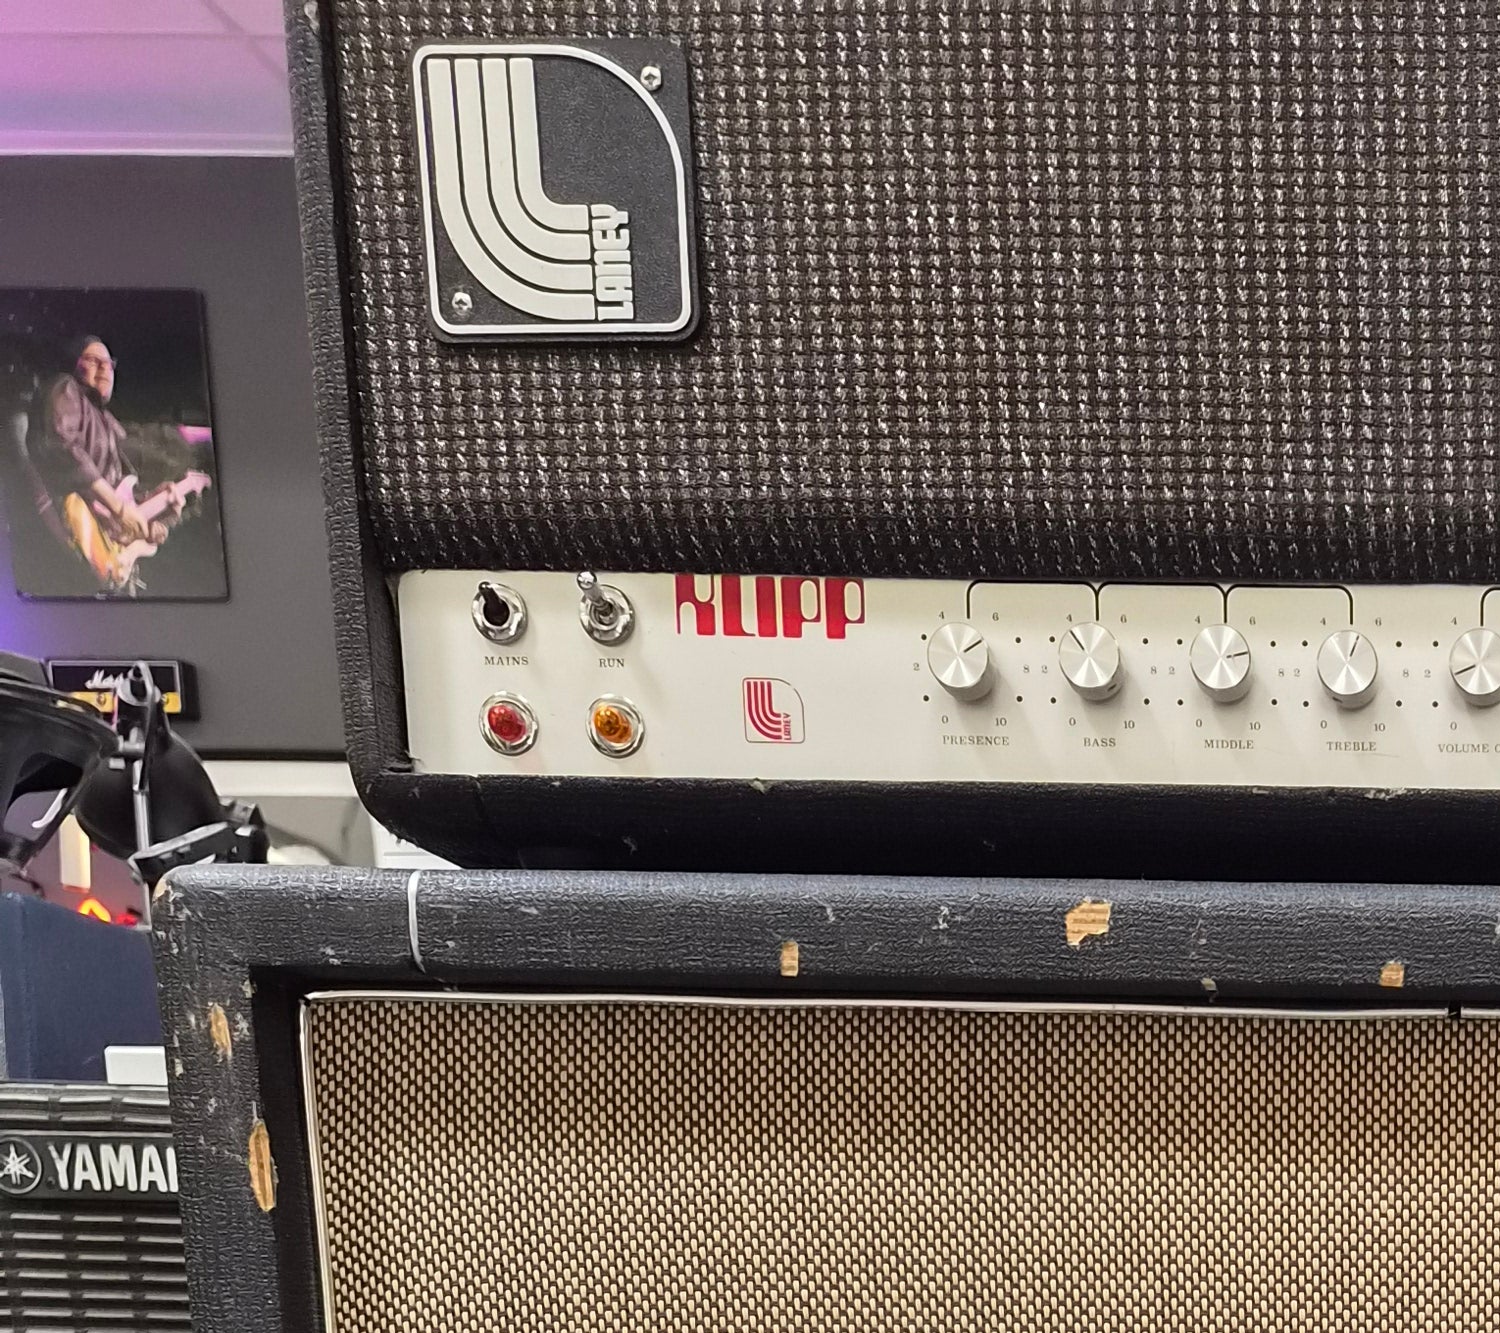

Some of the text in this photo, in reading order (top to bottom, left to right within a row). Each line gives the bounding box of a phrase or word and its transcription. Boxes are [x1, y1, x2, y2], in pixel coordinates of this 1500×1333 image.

[590, 204, 635, 321] LANEY
[675, 573, 865, 639] KLIPP
[938, 611, 945, 620] 4
[992, 612, 999, 621] 6
[1066, 614, 1073, 623] 4
[1120, 614, 1127, 624] 6
[1194, 615, 1201, 624] 4
[1249, 616, 1256, 625] 6
[1320, 617, 1326, 626] 4
[1375, 617, 1382, 627] 6
[1450, 617, 1457, 625] 4
[484, 656, 529, 667] MAINS
[598, 658, 626, 668] RUN
[942, 715, 949, 724] 0
[995, 717, 1007, 726] 10
[1069, 717, 1076, 726] 0
[1195, 719, 1203, 728] 0
[1123, 720, 1135, 729] 10
[1249, 722, 1261, 731] 10
[1320, 720, 1327, 729] 0
[1374, 723, 1386, 732] 10
[1450, 721, 1457, 730] 0
[942, 735, 1010, 746] PRESENCE
[1083, 737, 1116, 748] BASS
[1204, 739, 1254, 750] MIDDLE
[1326, 741, 1377, 752] TREBLE
[1438, 743, 1489, 753] VOLUME
